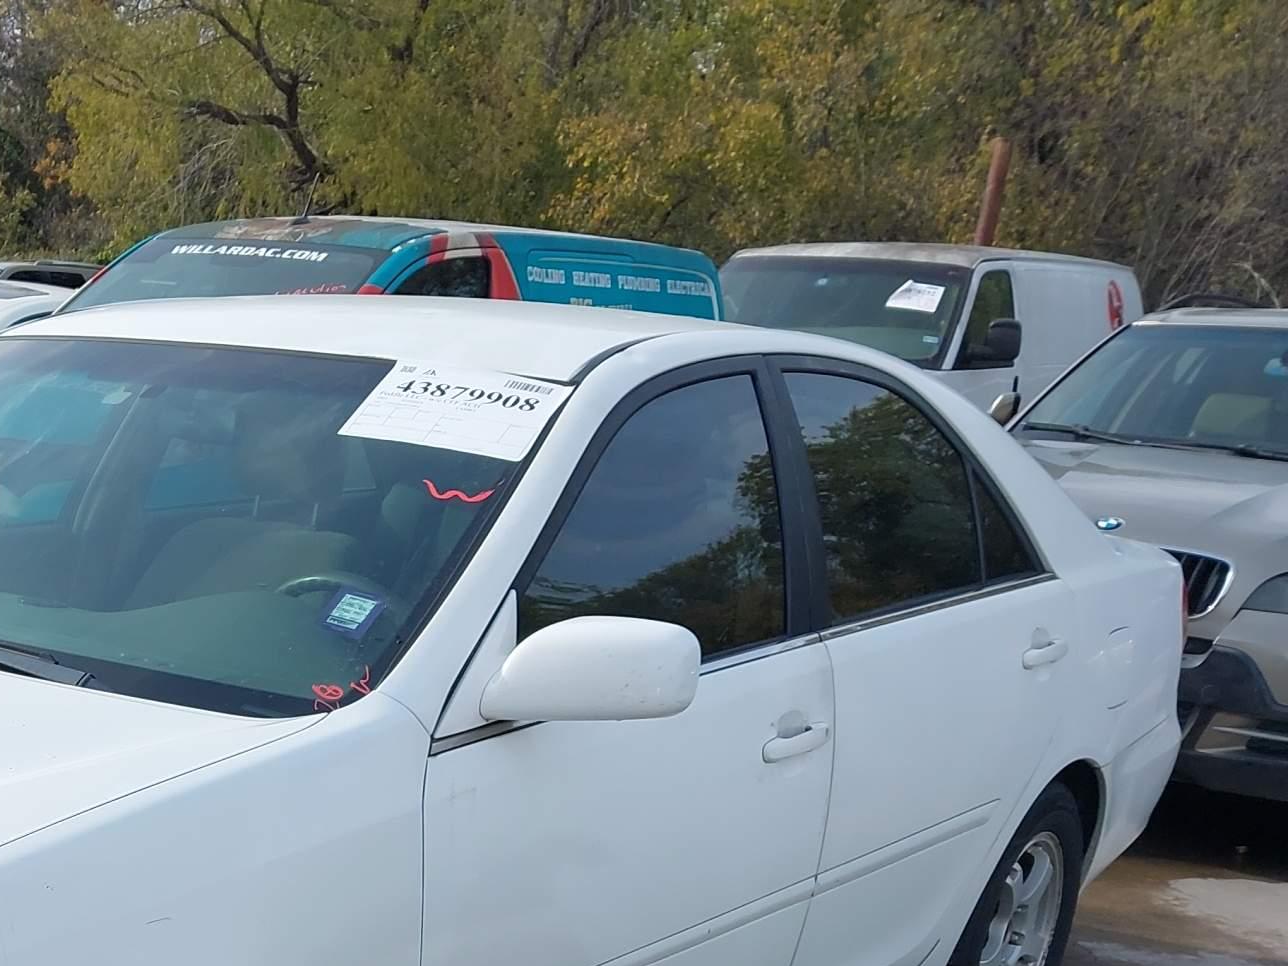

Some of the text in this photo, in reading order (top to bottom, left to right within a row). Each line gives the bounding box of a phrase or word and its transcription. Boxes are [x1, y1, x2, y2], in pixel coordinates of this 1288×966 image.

[171, 244, 329, 262] WILLARDAC.COM
[527, 266, 565, 284] COOLING
[572, 271, 611, 288] HEATING
[617, 275, 660, 292] PLUMBING
[397, 380, 540, 412] 43879908
